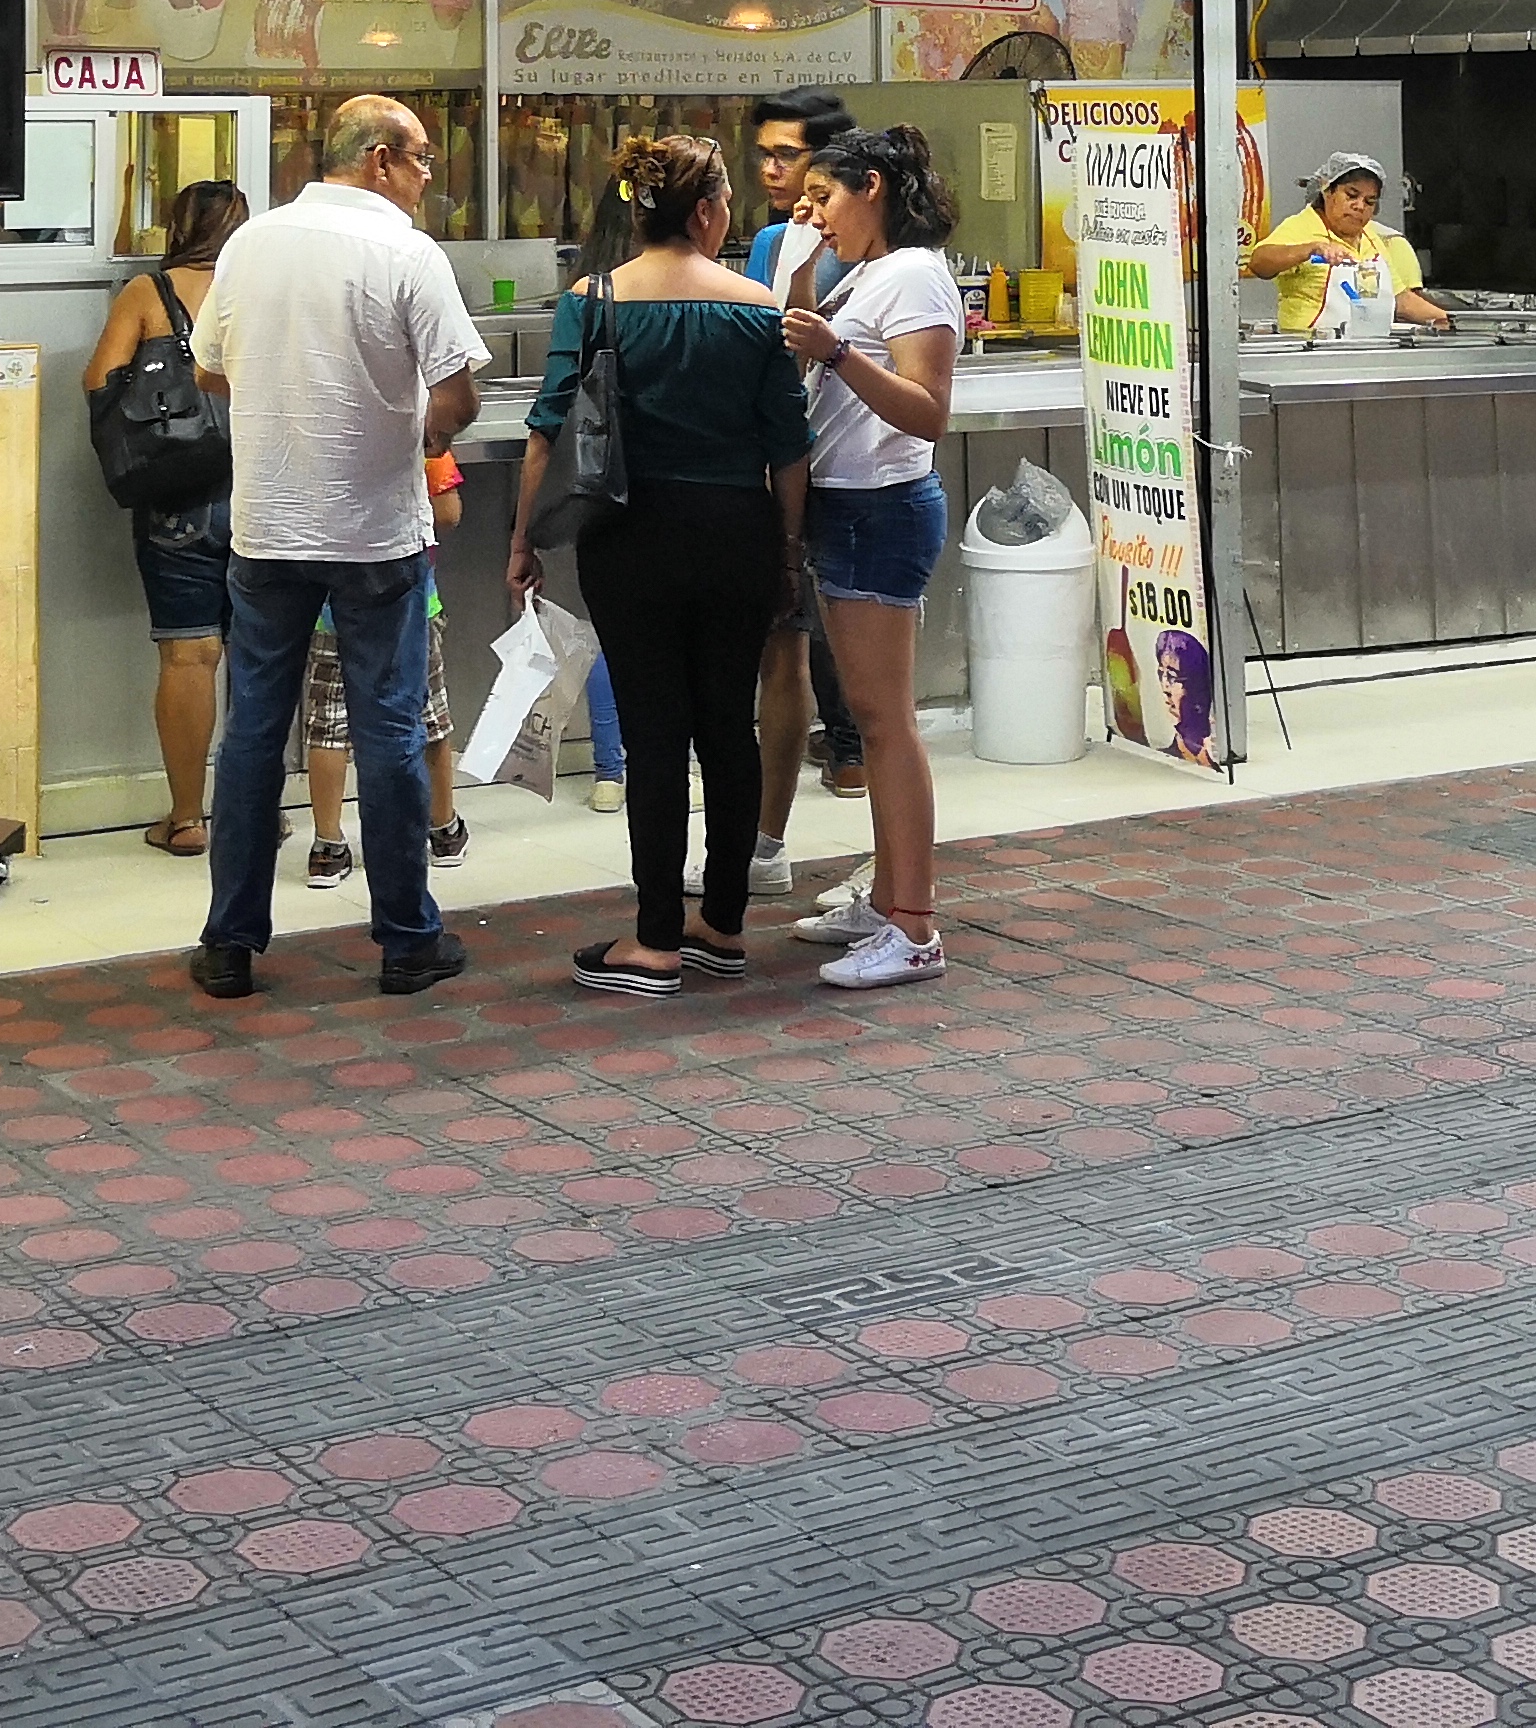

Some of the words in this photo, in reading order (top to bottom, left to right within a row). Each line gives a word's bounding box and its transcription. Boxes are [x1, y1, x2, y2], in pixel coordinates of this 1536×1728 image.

[515, 21, 613, 64] Elite
[54, 56, 146, 90] CAJA
[513, 68, 538, 84] Su
[551, 69, 607, 86] lugar
[738, 72, 760, 84] en
[773, 69, 858, 84] Tampico
[1046, 102, 1160, 126] DELICIOSOS
[1094, 258, 1150, 311] JOHN
[1085, 311, 1175, 371] LEMMON
[1105, 378, 1145, 416] NIEVE
[1149, 382, 1171, 419] DE
[1091, 410, 1183, 480] Limón
[1093, 471, 1111, 506] CON
[1112, 479, 1132, 512] UN
[1133, 483, 1187, 525] TOQUE
